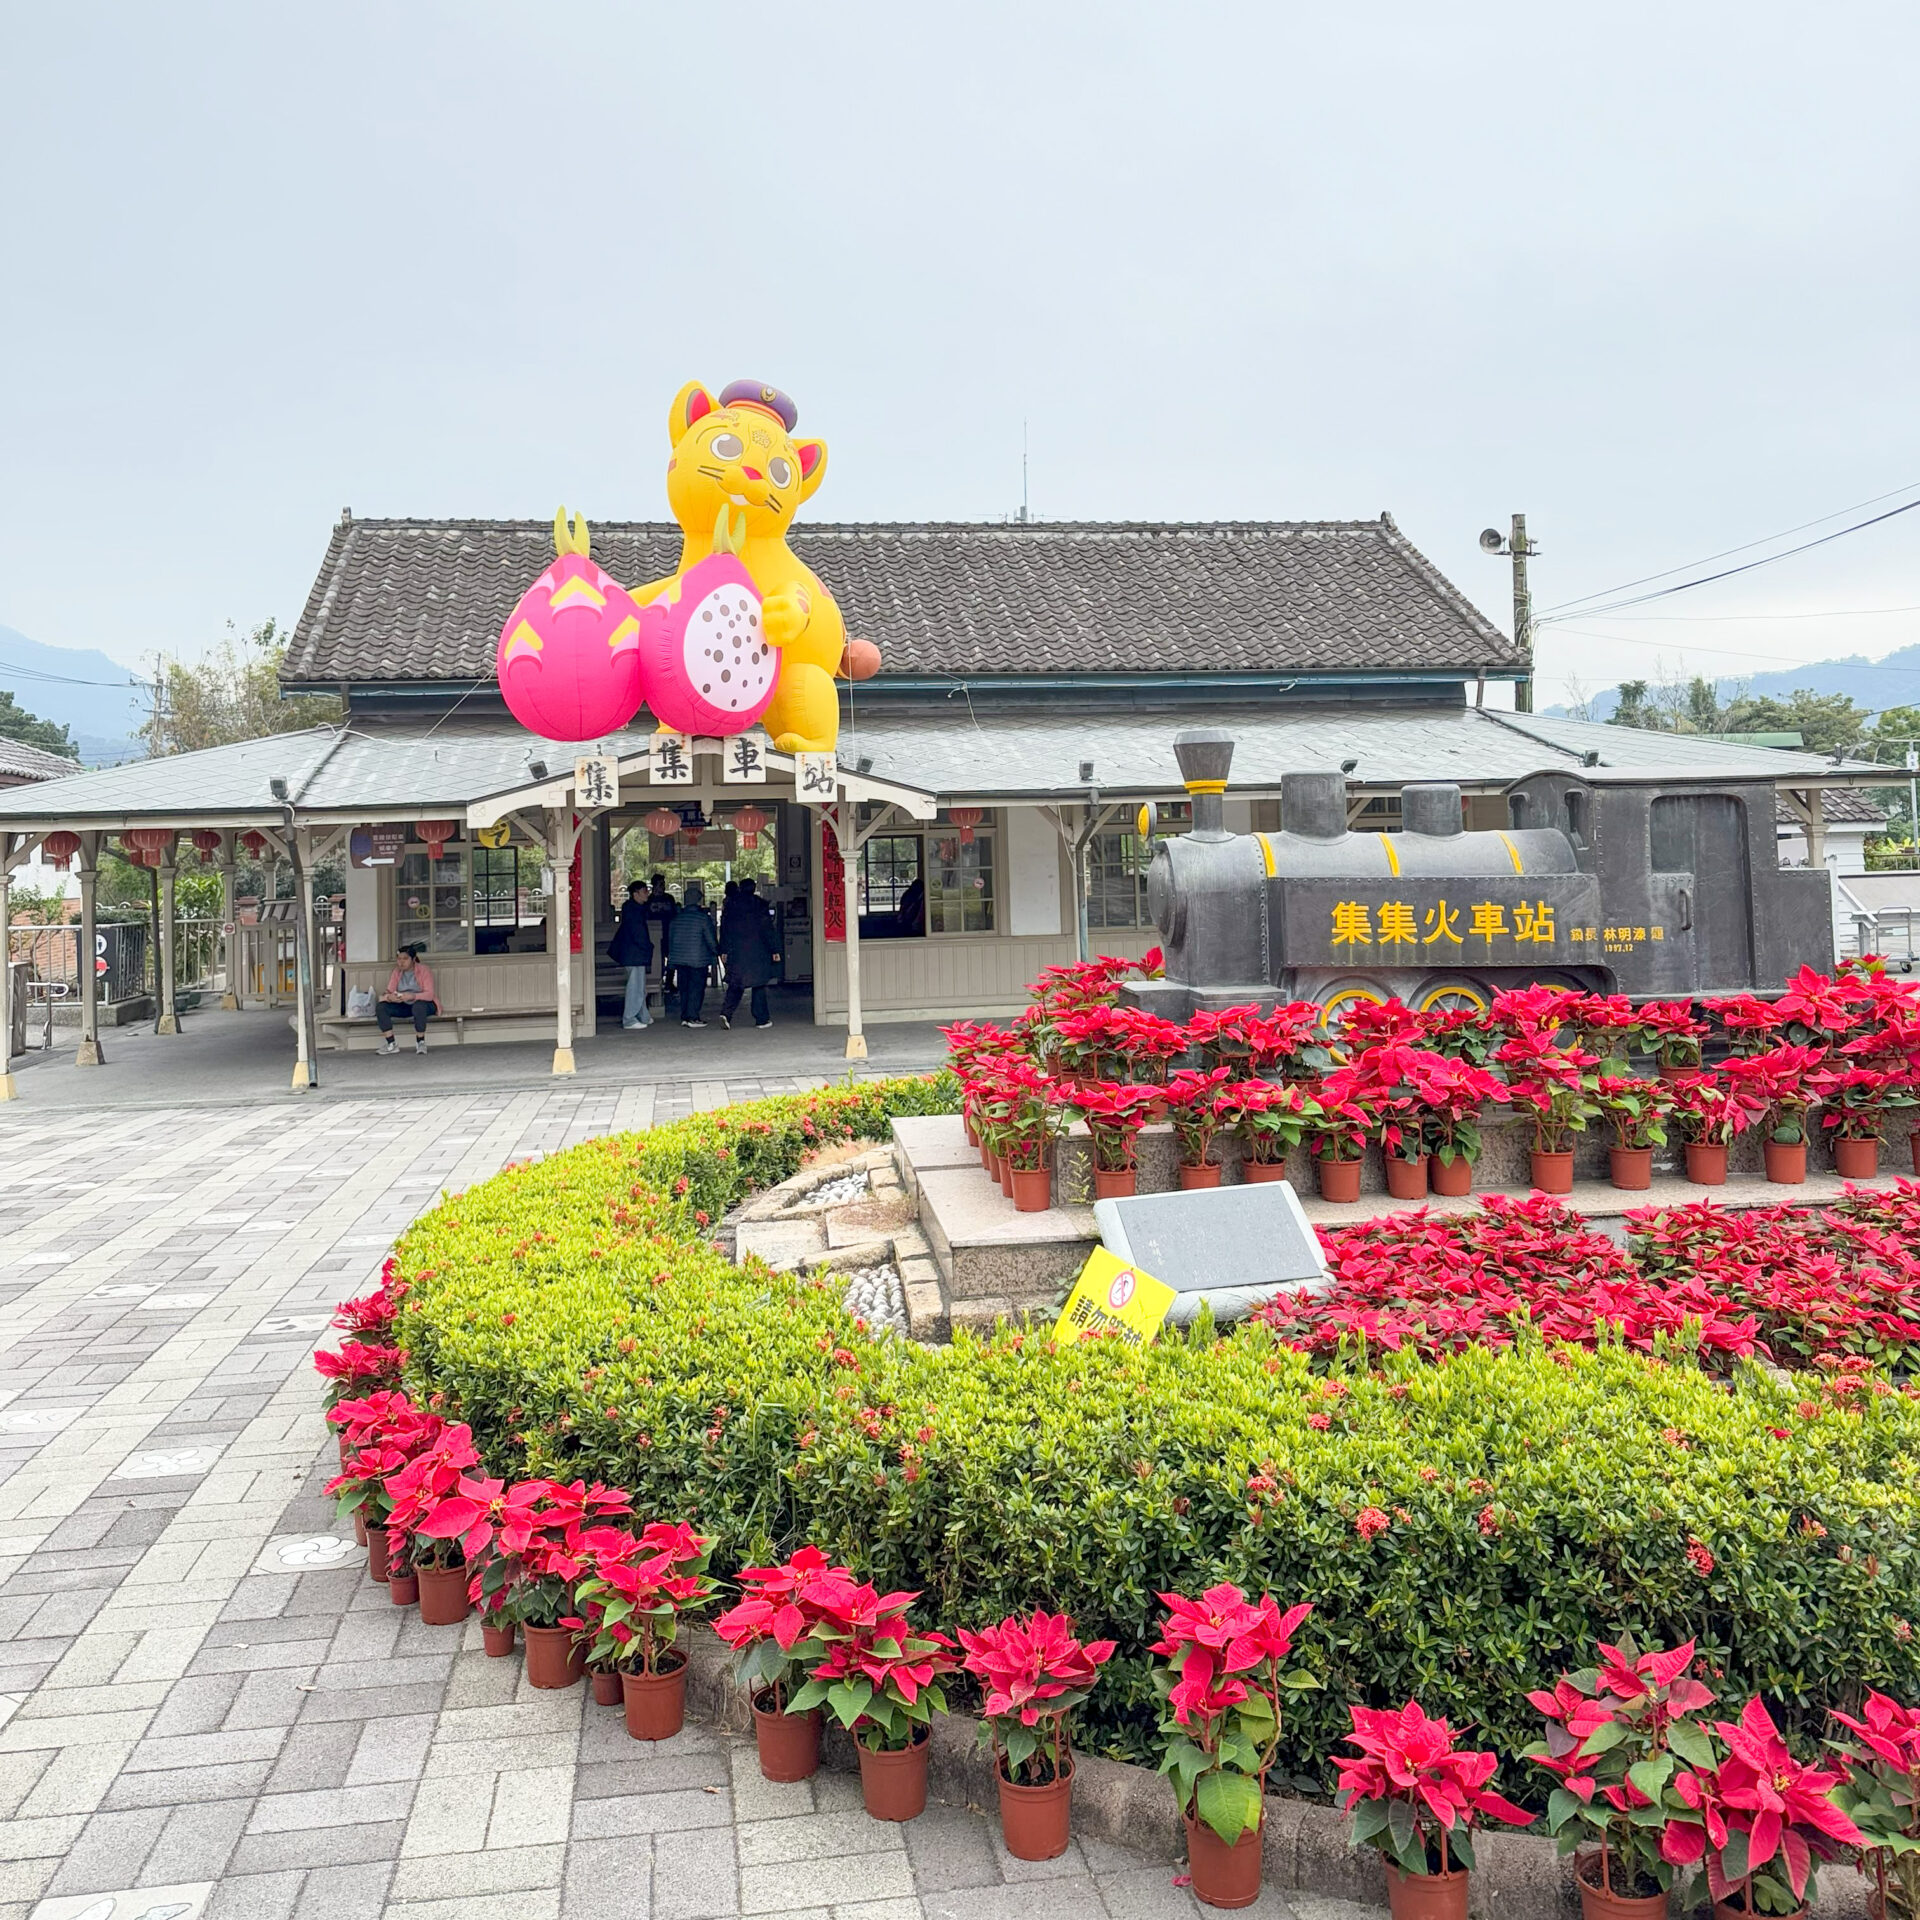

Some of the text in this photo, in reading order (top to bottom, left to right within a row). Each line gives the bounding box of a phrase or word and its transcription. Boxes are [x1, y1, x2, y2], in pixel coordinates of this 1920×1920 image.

[1331, 900, 1556, 944] 集集火車站
